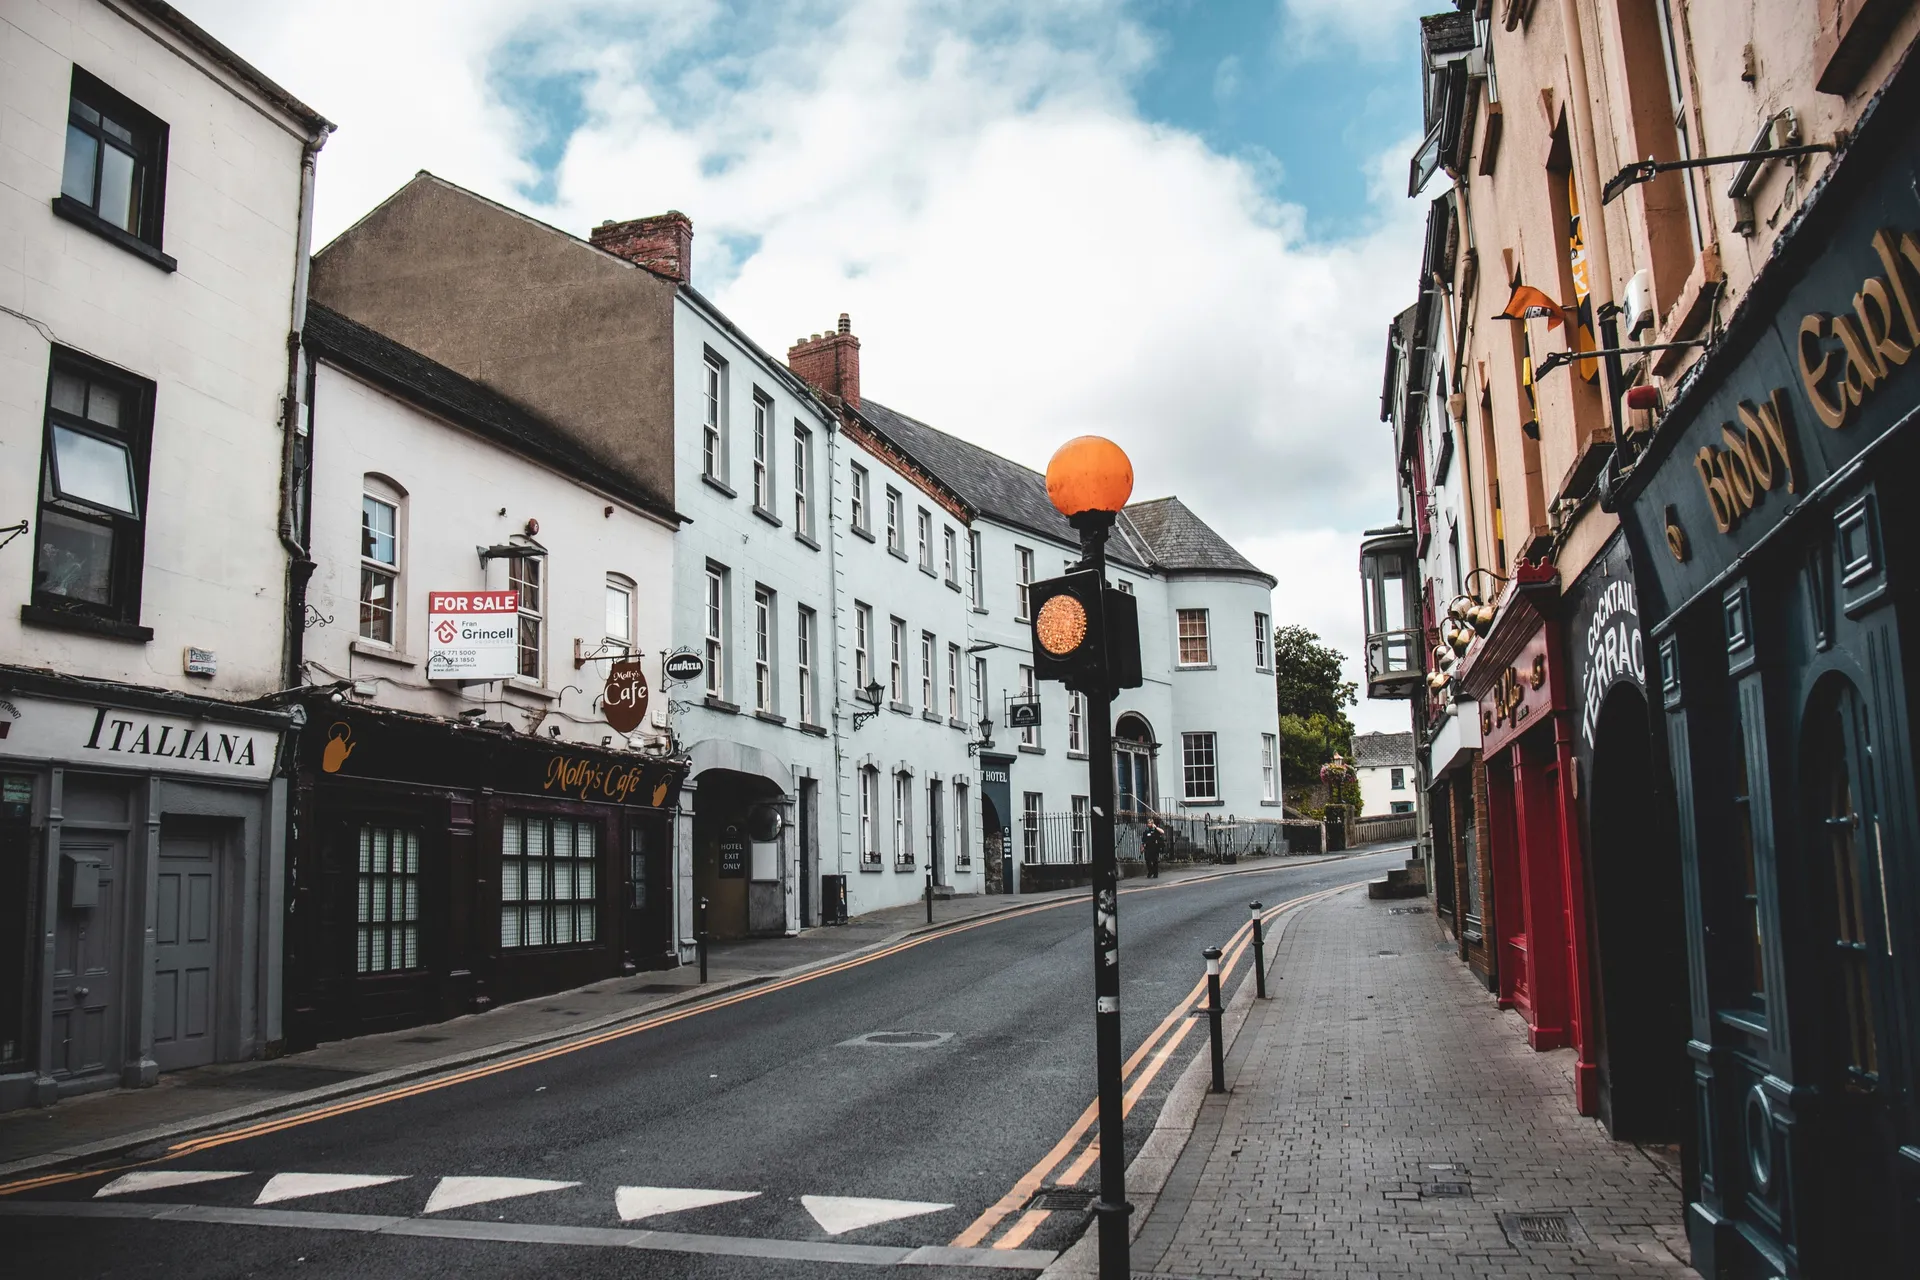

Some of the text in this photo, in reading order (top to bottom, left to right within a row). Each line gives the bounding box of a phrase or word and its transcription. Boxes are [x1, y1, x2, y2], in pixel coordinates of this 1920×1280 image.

[433, 596, 515, 611] FOR SALE
[1587, 580, 1637, 656] COCKTAIL
[461, 628, 513, 640] Grincell
[668, 660, 702, 671] LAVAZZA
[613, 670, 641, 681] Molly's
[604, 681, 647, 708] Cafe
[83, 706, 256, 766] ITALIANA
[543, 756, 643, 802] Molly's Café
[985, 770, 1008, 783] HOTEL
